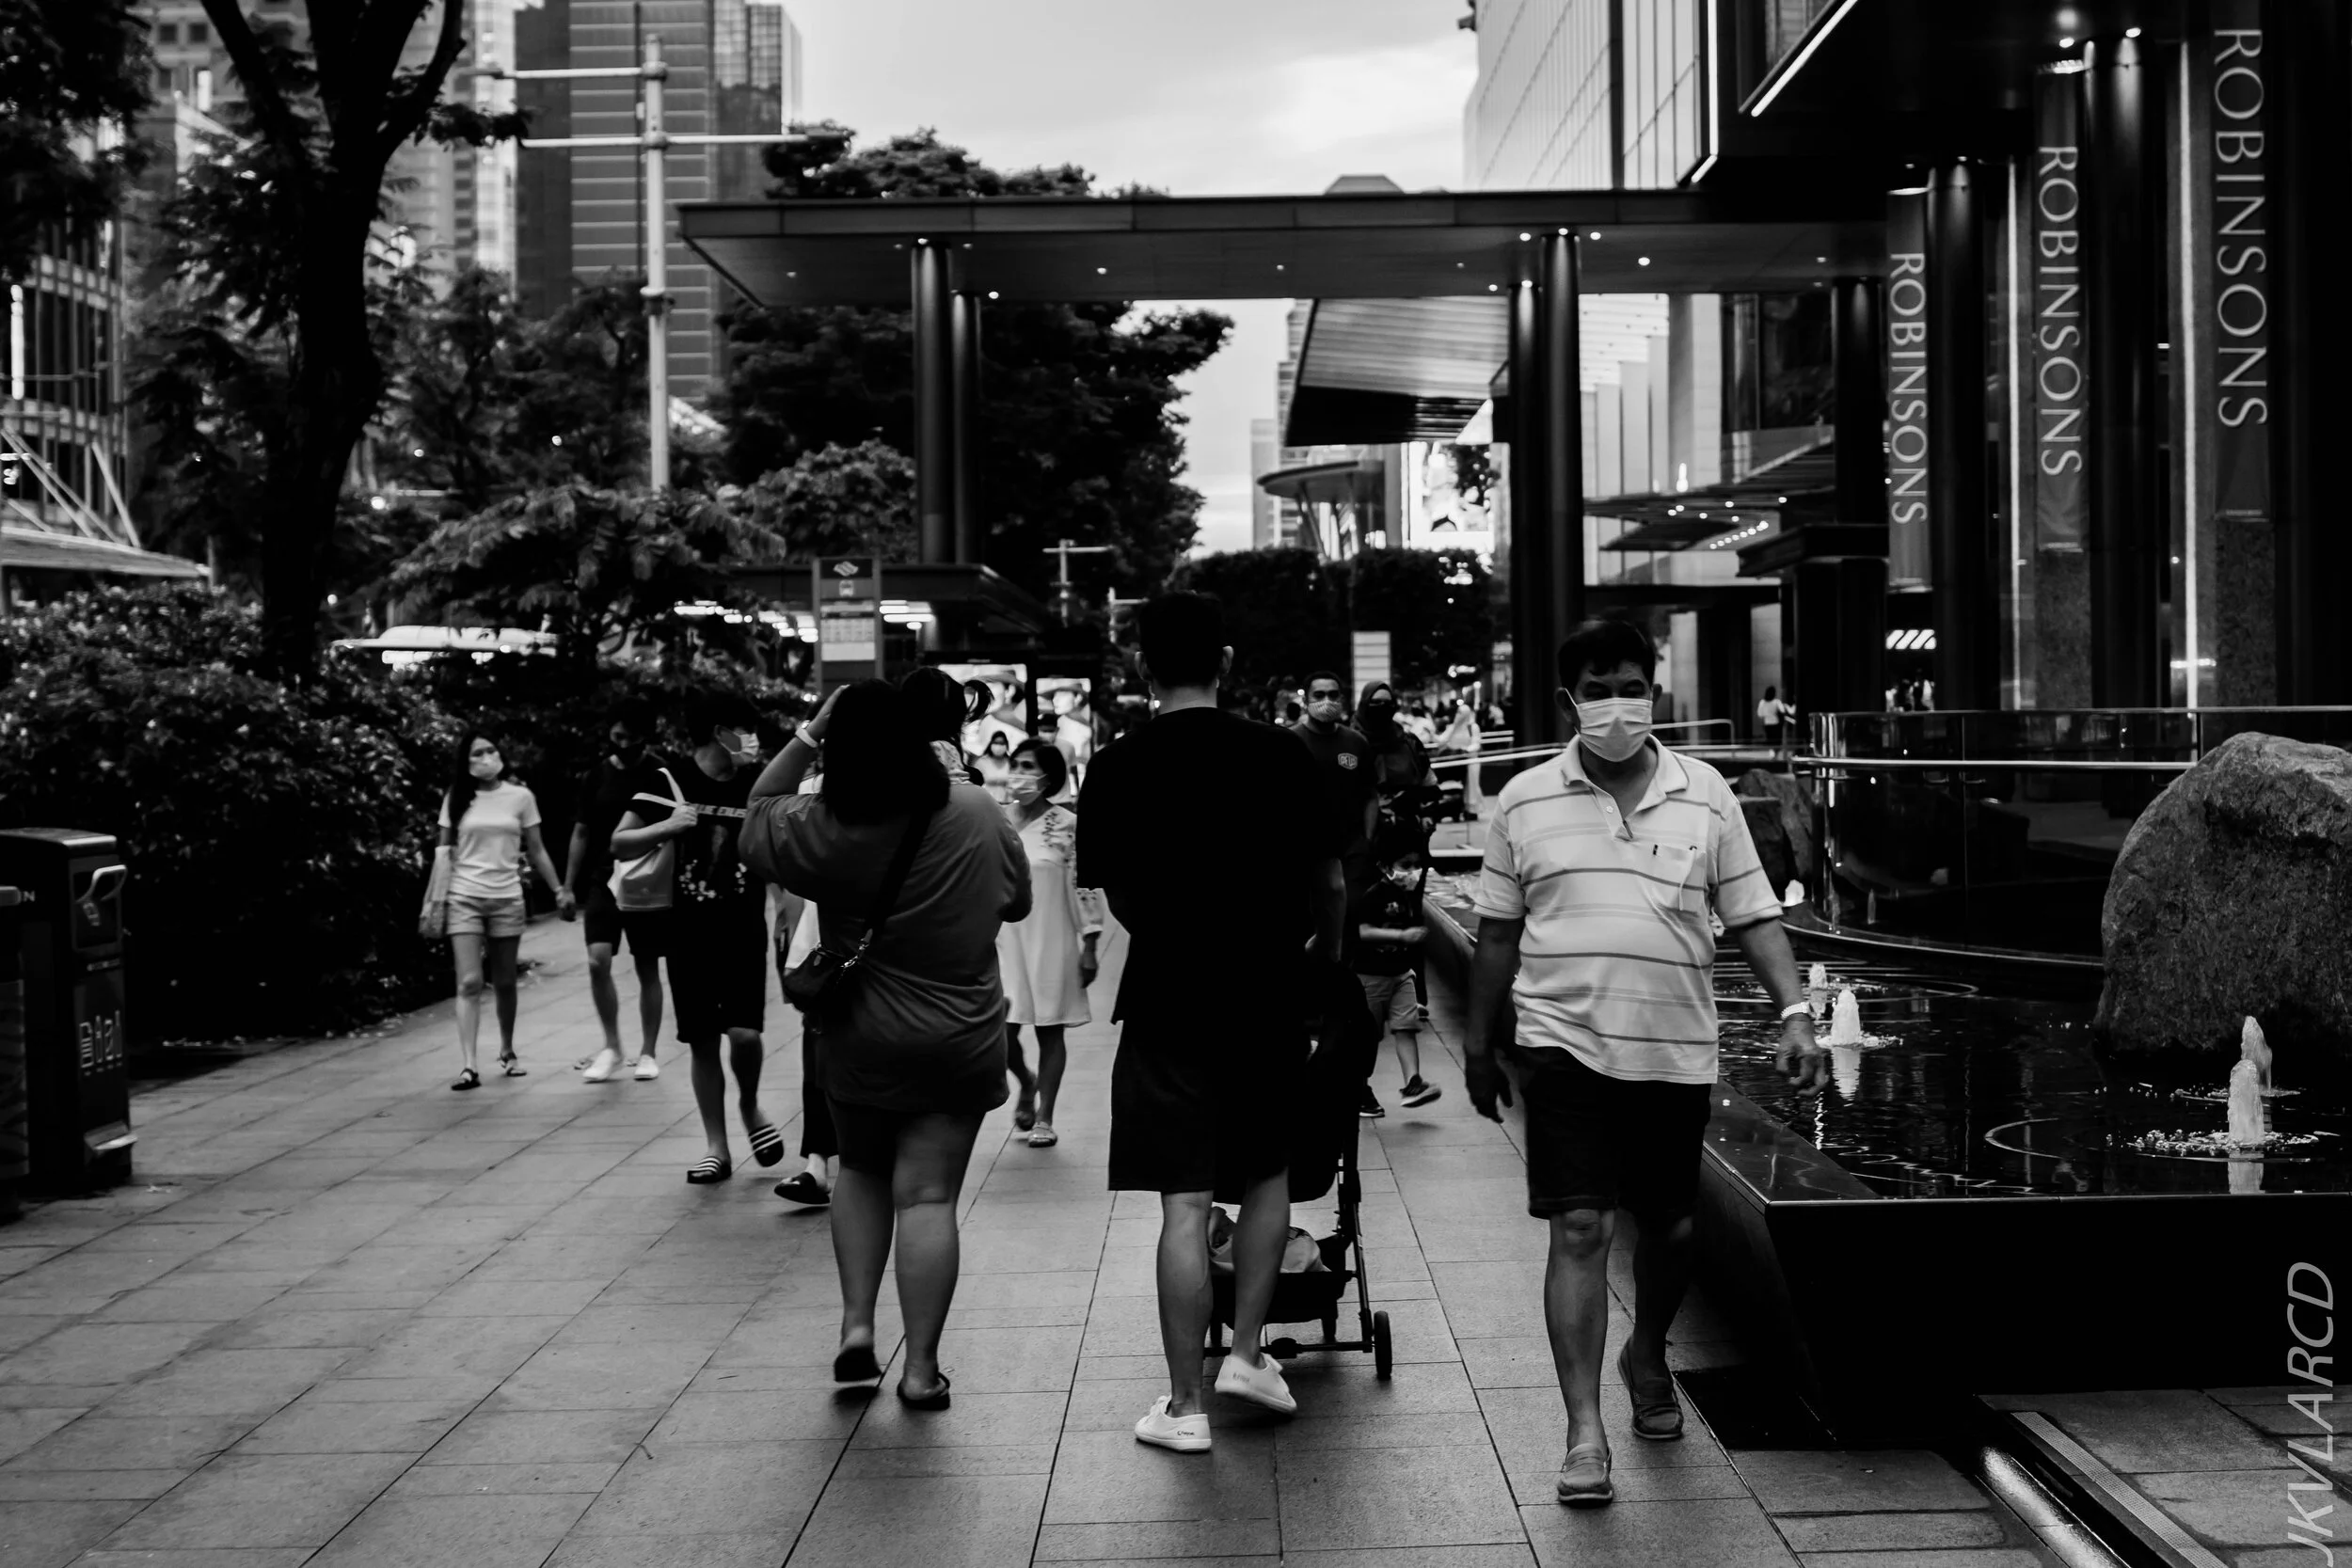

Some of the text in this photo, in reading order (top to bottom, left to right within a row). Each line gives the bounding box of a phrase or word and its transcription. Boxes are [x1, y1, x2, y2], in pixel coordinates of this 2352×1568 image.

[1889, 251, 1928, 525] ROBINSONS
[2038, 145, 2082, 476] ROBINSONS
[2214, 28, 2268, 428] ROBINSONS
